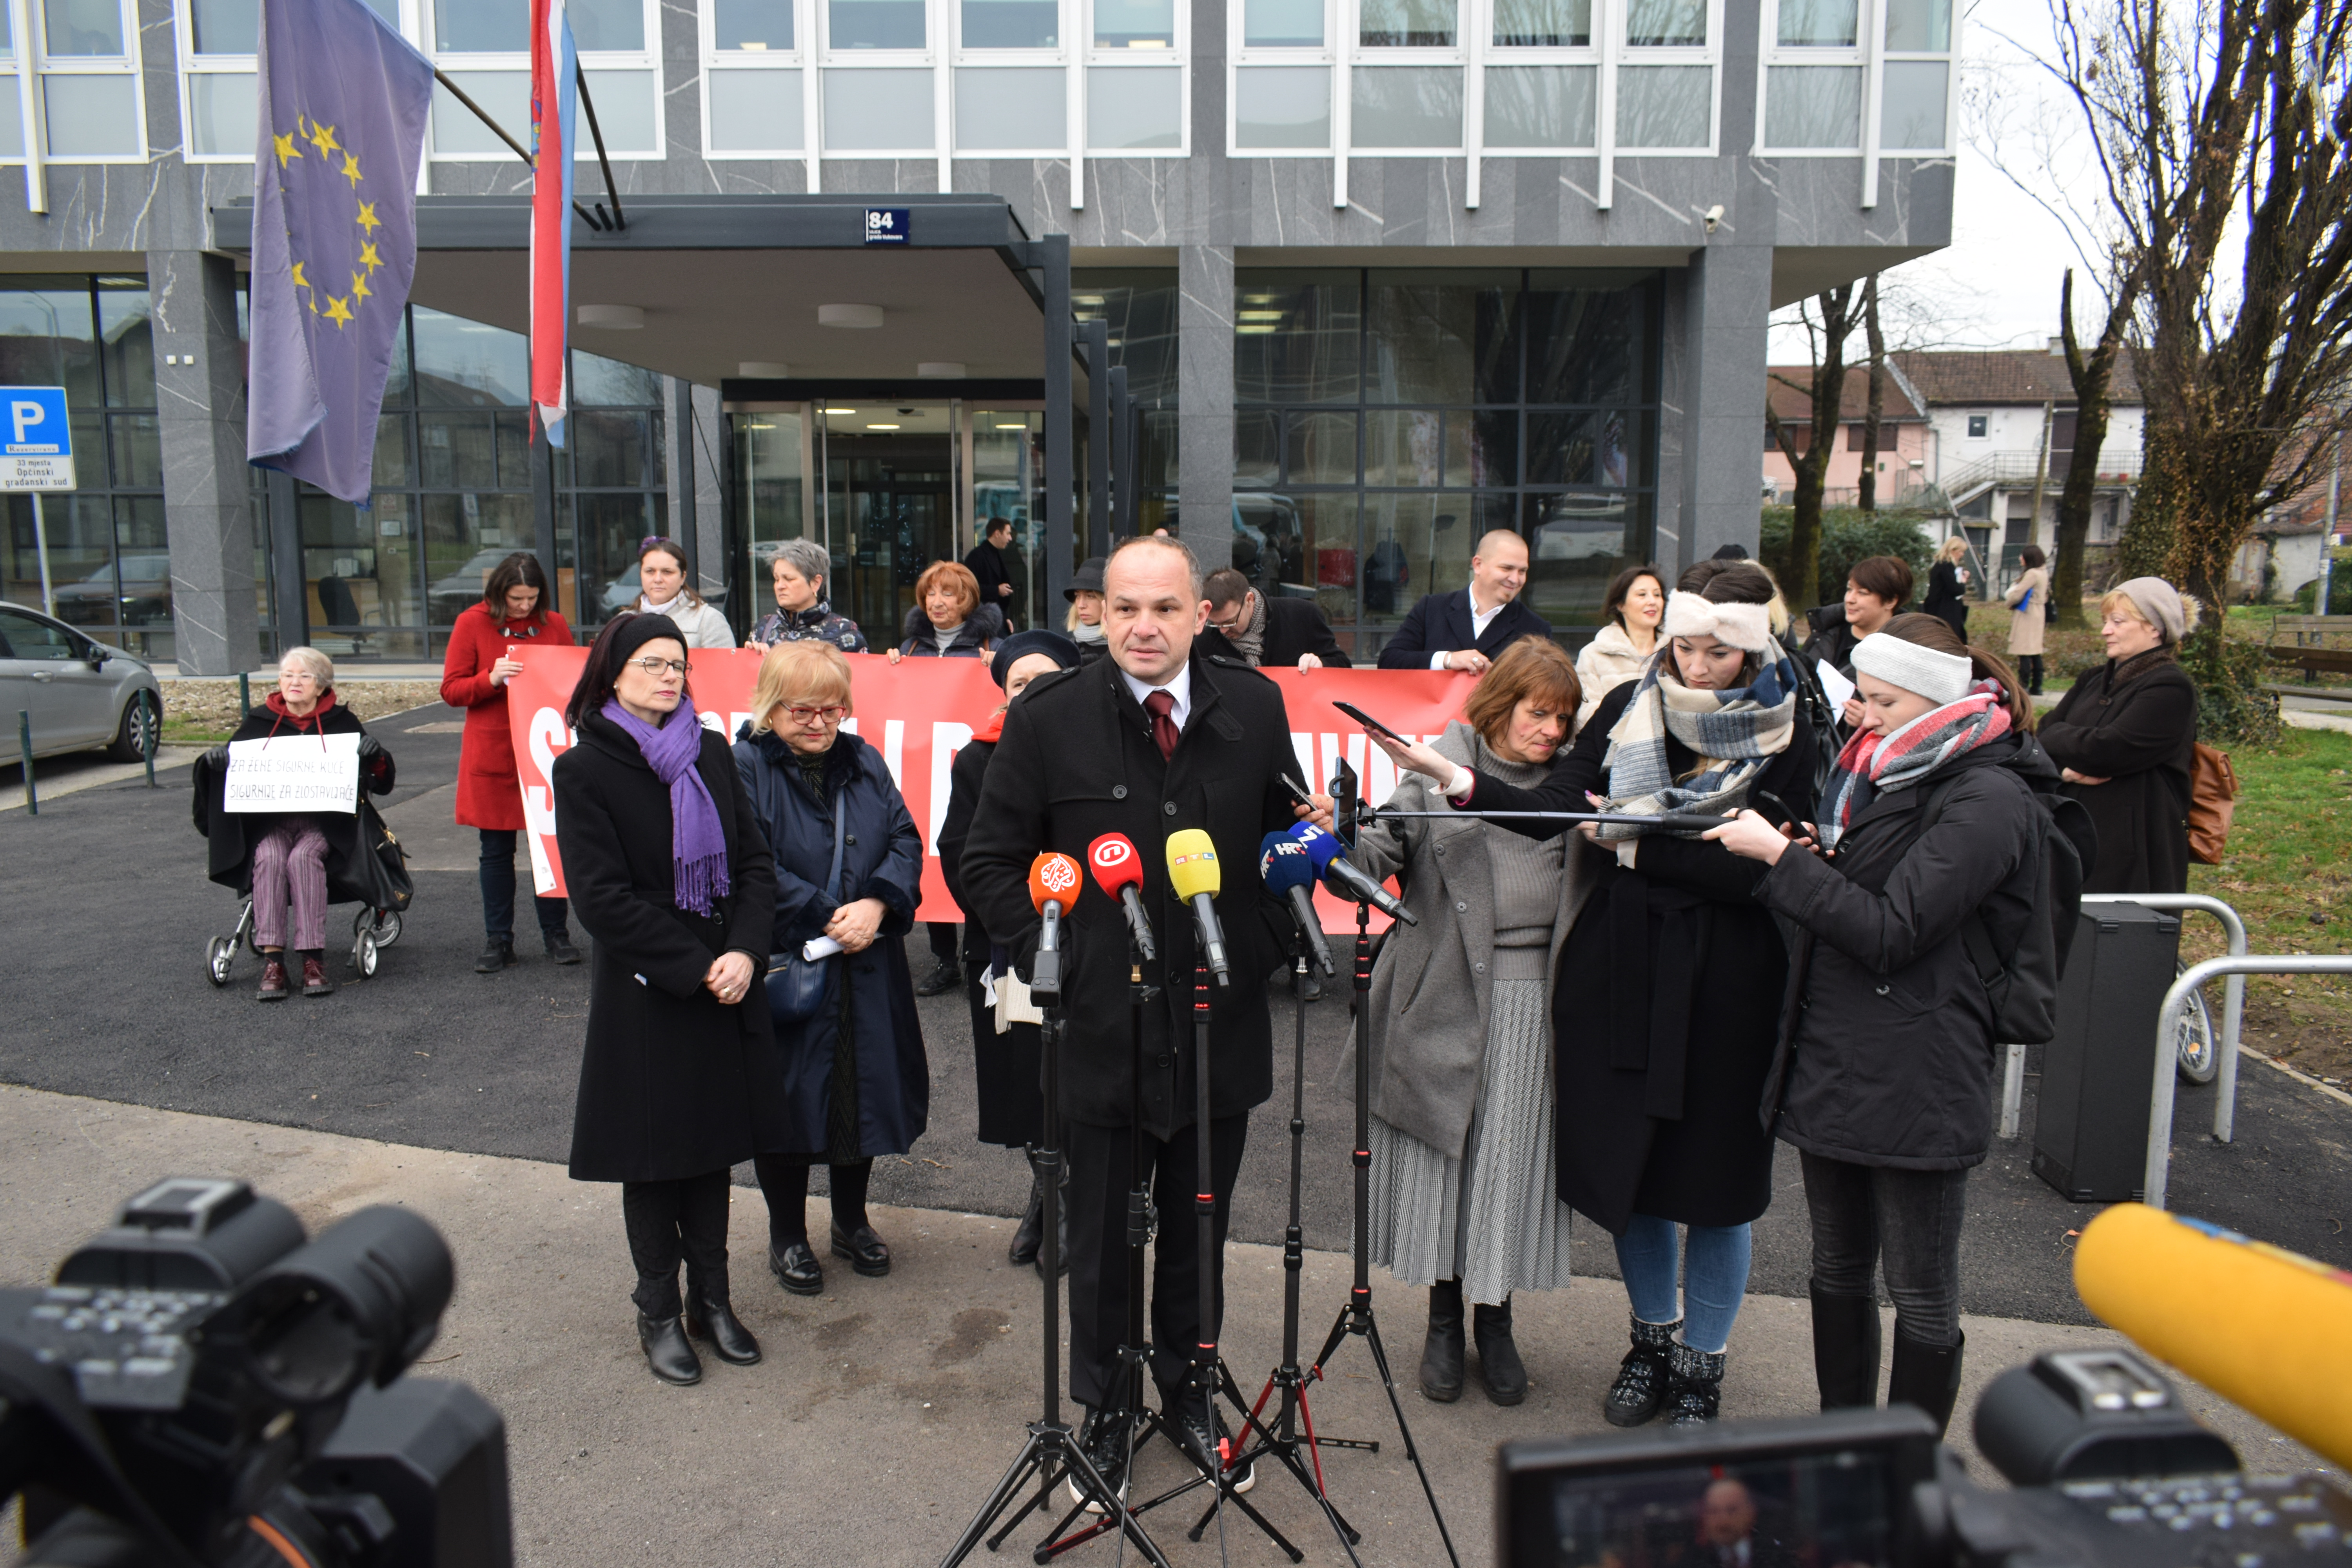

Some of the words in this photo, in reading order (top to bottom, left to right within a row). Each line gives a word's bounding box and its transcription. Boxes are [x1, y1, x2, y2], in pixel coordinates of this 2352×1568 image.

[869, 212, 893, 229] 84
[11, 401, 45, 442] P
[17, 468, 54, 477] Općinski
[230, 759, 245, 772] ZA
[276, 760, 316, 773] SIGURNE
[230, 784, 276, 798] SIGURNIJE
[279, 784, 291, 798] ZA
[1274, 843, 1306, 855] HRT
[1176, 853, 1213, 865] RTL
